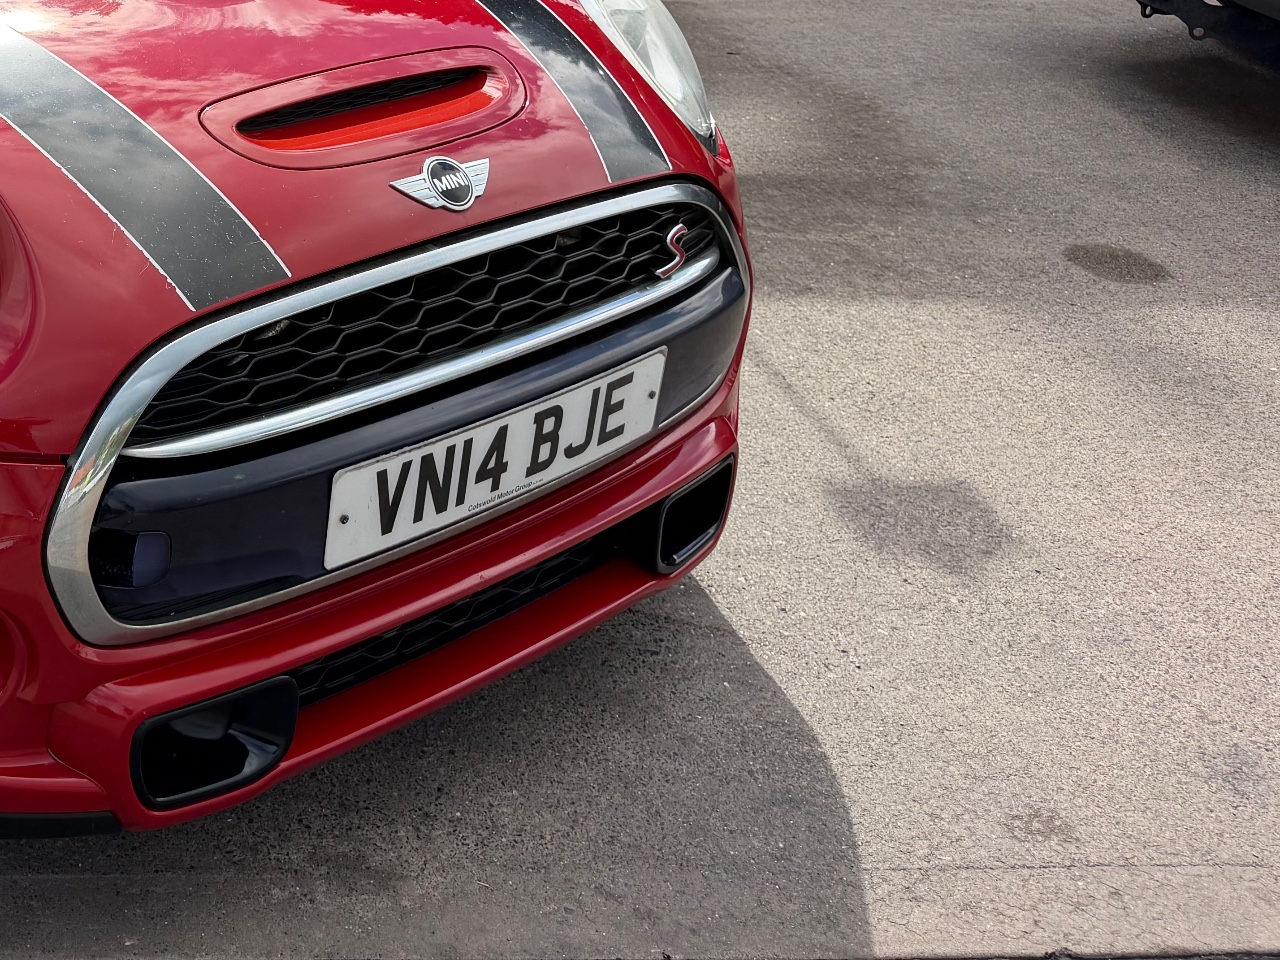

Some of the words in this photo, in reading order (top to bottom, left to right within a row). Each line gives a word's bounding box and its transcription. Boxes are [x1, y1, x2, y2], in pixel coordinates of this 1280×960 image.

[433, 172, 469, 192] MINI
[655, 223, 688, 279] S
[376, 423, 509, 536] VN14
[525, 371, 635, 478] BJE
[467, 494, 497, 512] Cotswold
[496, 488, 515, 500] Motor
[515, 481, 533, 493] Group
